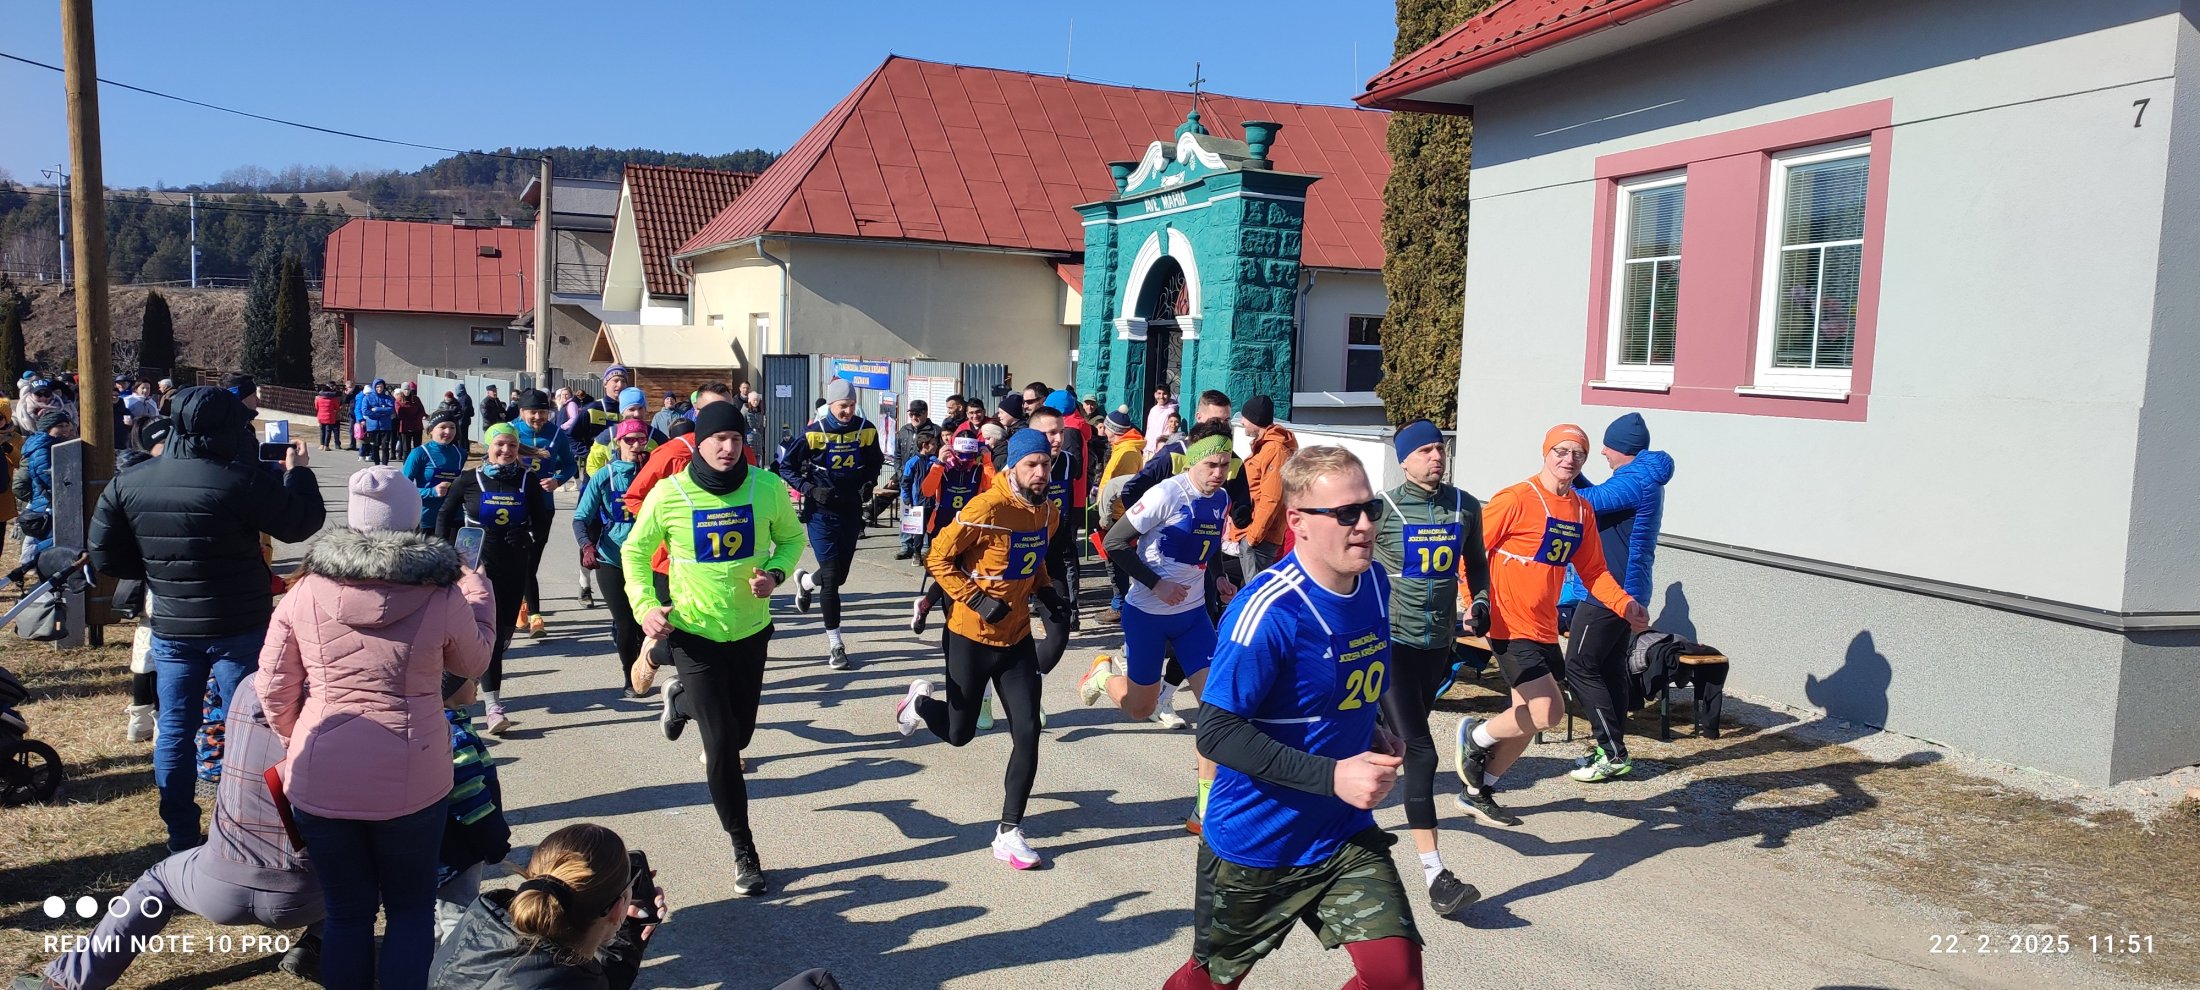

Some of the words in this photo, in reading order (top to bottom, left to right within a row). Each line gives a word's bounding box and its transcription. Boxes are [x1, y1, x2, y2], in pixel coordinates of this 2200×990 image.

[2133, 98, 2151, 128] 7
[1161, 190, 1188, 210] MARIA
[831, 454, 856, 470] 24
[952, 495, 964, 509] 8
[494, 507, 510, 526] 3
[696, 520, 718, 528] JOZEFA
[706, 510, 739, 520] MEMORIÁL
[1417, 527, 1449, 535] MEMORIÁL
[707, 530, 743, 558] 19
[1198, 540, 1211, 561] 1
[1546, 538, 1572, 563] 31
[1020, 551, 1037, 575] 2
[1417, 545, 1454, 574] 10
[1338, 660, 1385, 711] 20
